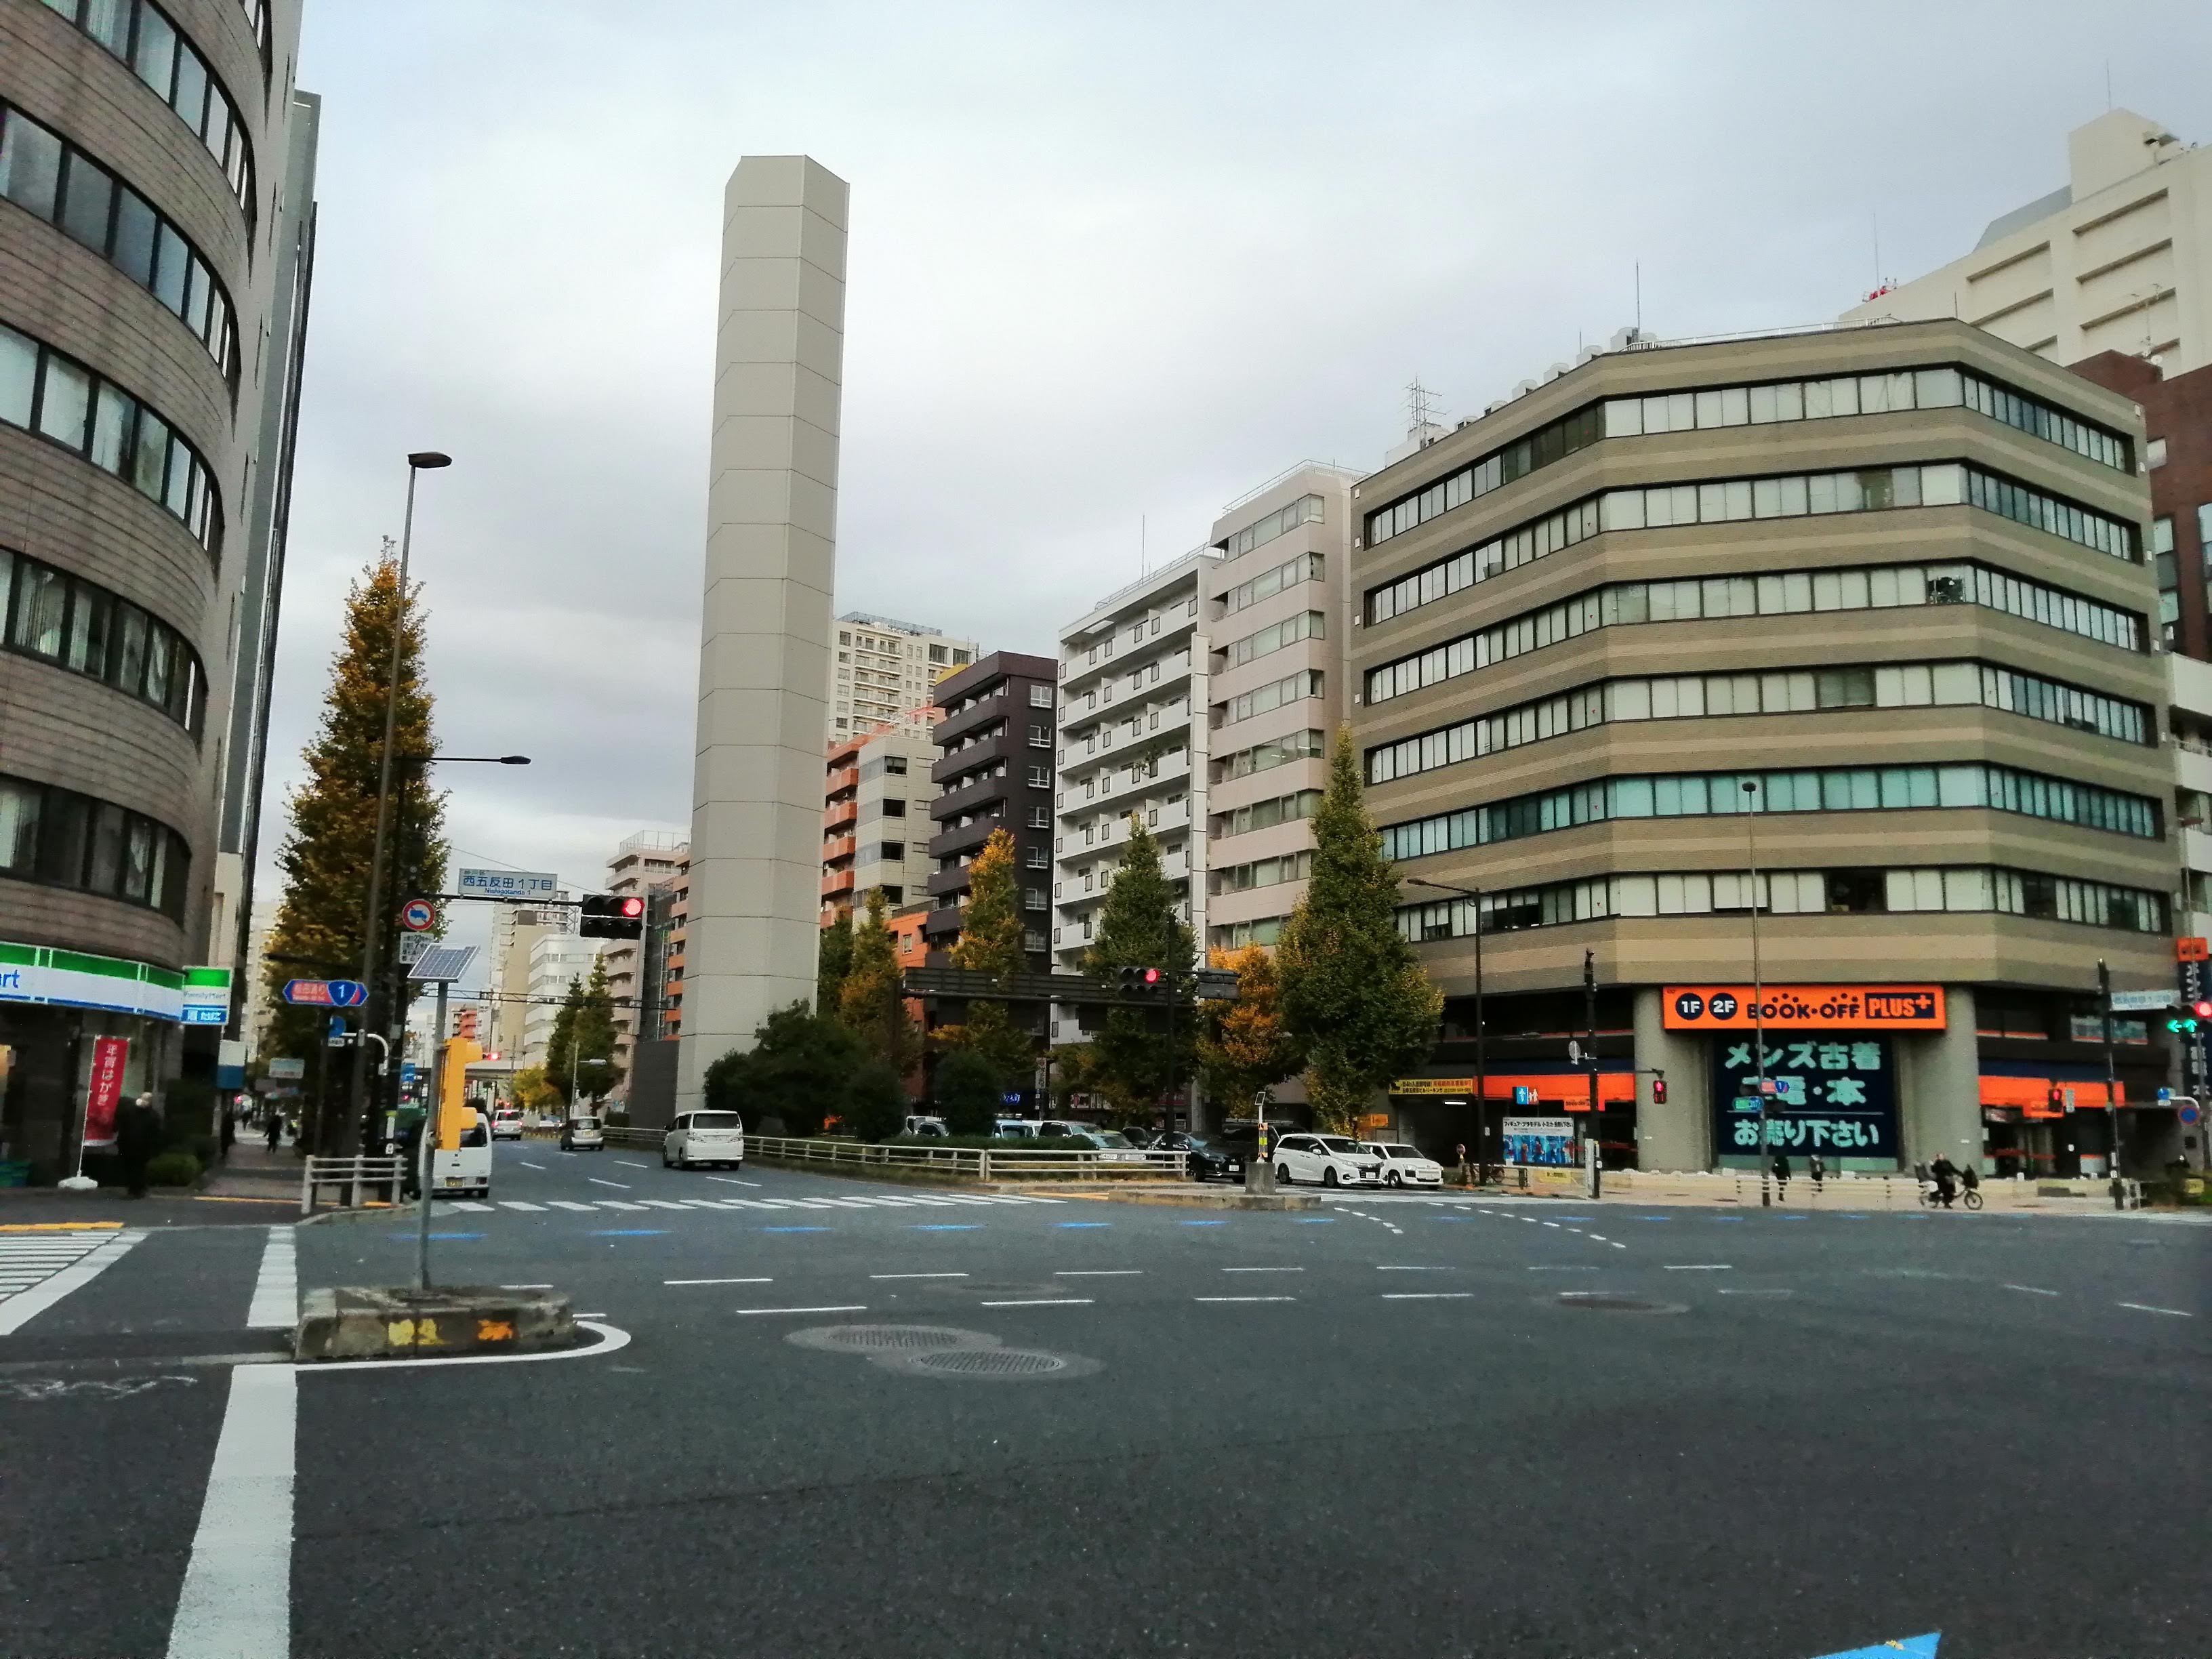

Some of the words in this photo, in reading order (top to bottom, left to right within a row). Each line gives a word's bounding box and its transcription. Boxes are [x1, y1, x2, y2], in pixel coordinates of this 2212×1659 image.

[463, 876, 552, 890] 西五反田1丁目
[485, 887, 525, 895] Nishigotanda
[0, 969, 20, 989] rt
[339, 984, 345, 998] 1
[1681, 1001, 1700, 1013] 1F
[1713, 1000, 1735, 1013] 2F
[1725, 1042, 1881, 1069] メンズ古着
[1734, 1119, 1880, 1147] お売り下さい
